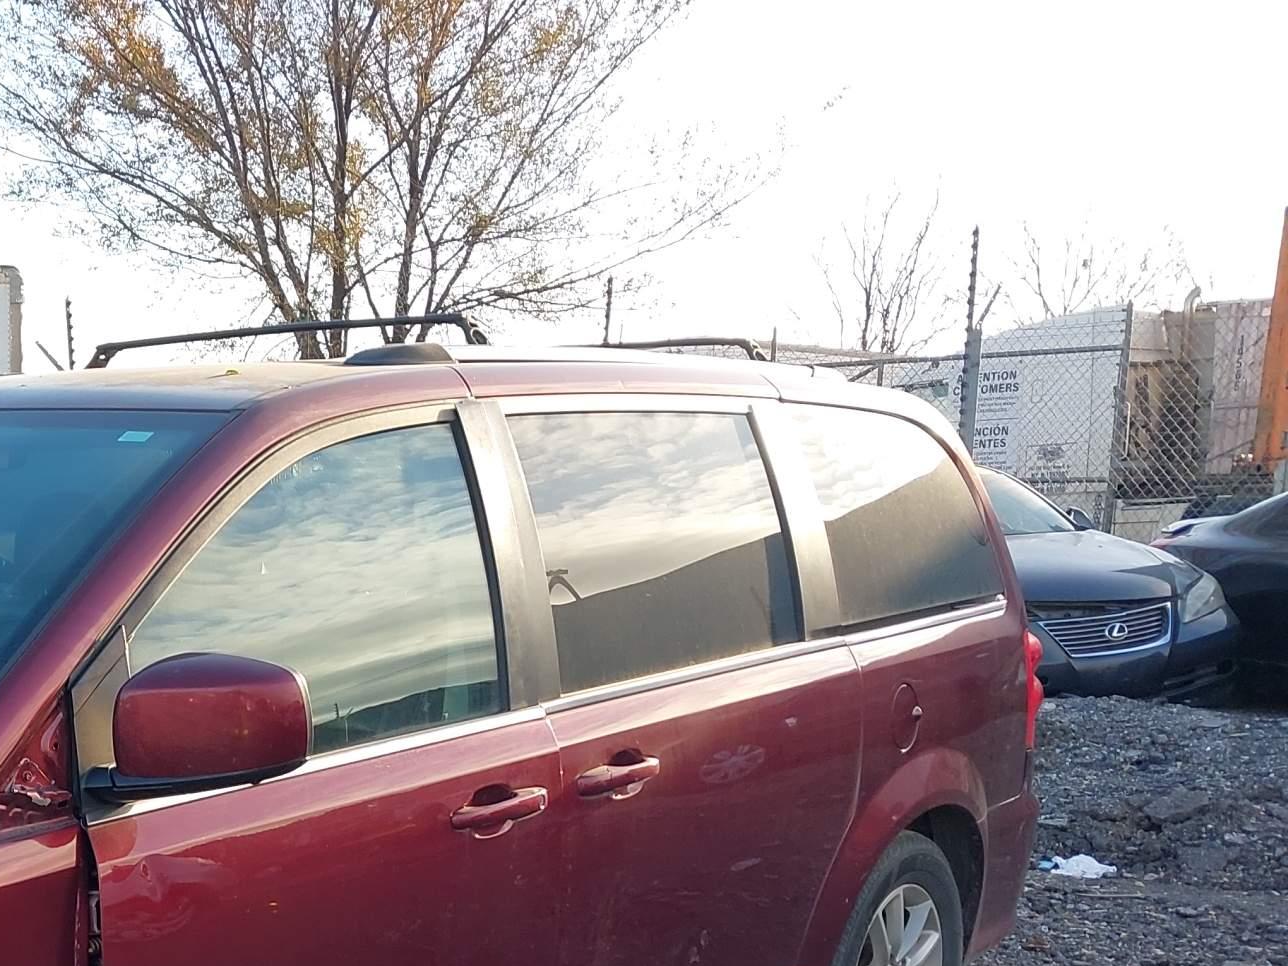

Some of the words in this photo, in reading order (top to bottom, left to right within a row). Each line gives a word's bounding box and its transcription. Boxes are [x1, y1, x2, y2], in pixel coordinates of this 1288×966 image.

[957, 370, 1017, 384] ANTION
[953, 382, 1019, 396] COMERS
[974, 424, 1009, 437] NCIÓN
[973, 438, 1006, 449] ENTES
